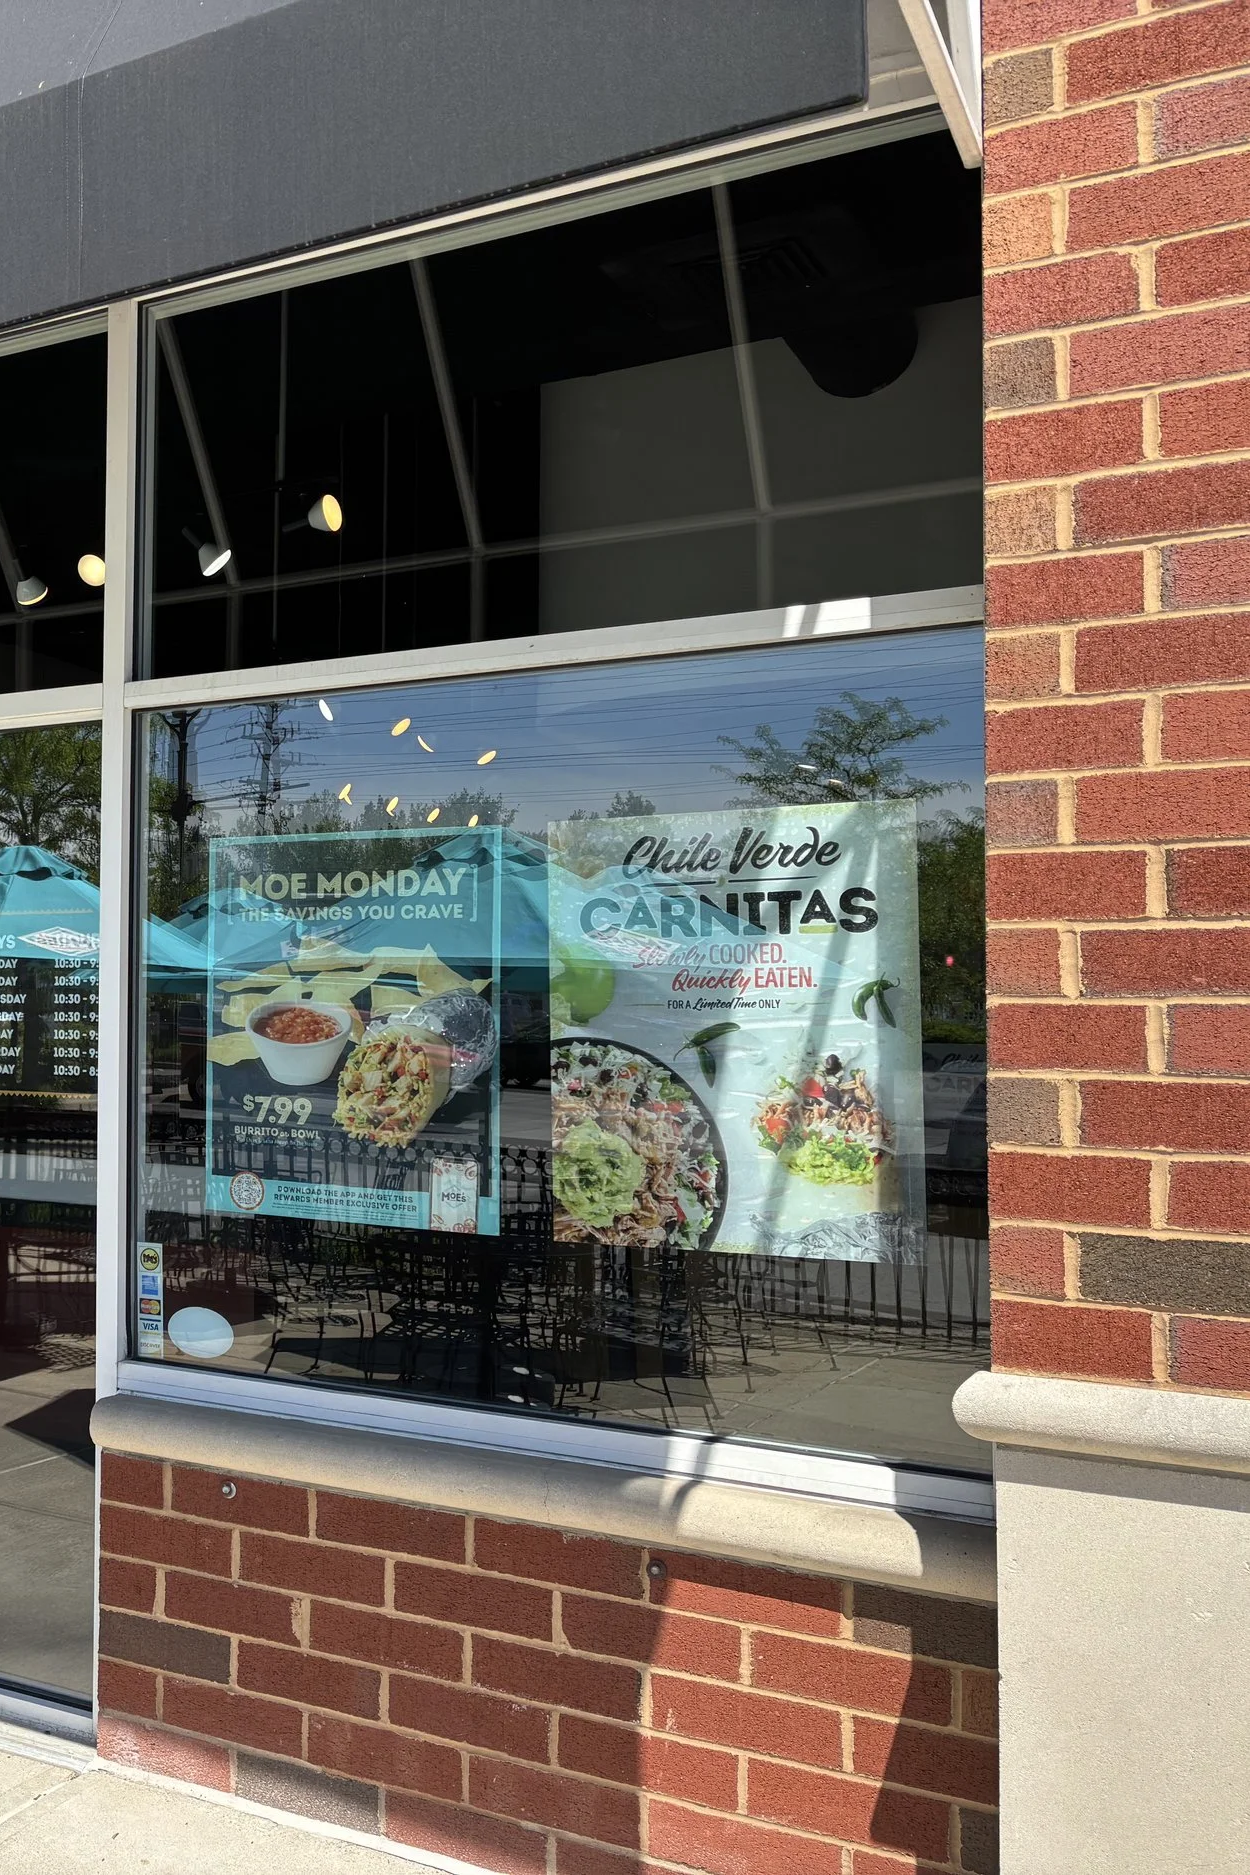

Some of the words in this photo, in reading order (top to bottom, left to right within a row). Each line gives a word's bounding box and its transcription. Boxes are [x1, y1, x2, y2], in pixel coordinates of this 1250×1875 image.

[622, 830, 721, 879] Chile
[728, 826, 841, 876] Verde
[239, 873, 307, 901] MOE
[317, 867, 467, 899] MONDAY
[240, 907, 270, 923] THE
[274, 905, 352, 922] SAVINGS
[358, 904, 396, 920] YOU
[400, 903, 464, 920] CRAVE
[579, 886, 879, 939] CARNITAS
[54, 959, 81, 969] 10:30
[632, 944, 707, 971] Slowly
[709, 943, 787, 965] COOKED.
[54, 976, 81, 986] 10:30
[671, 966, 751, 994] Quickly
[754, 966, 818, 989] EATEN.
[54, 994, 81, 1004] 10:30
[667, 1000, 684, 1010] FOR
[685, 1000, 692, 1009] A
[692, 998, 734, 1013] Limited
[733, 996, 757, 1010] Time
[758, 999, 781, 1009] ONLY
[54, 1011, 81, 1022] 10:30
[54, 1029, 81, 1040] 10:30
[54, 1047, 81, 1058] 10:30
[54, 1065, 81, 1076] 10:30
[242, 1094, 312, 1125] $7.99
[234, 1125, 279, 1137] BURRITO
[291, 1129, 321, 1139] BOWL
[274, 1193, 311, 1203] REWARDS
[312, 1197, 344, 1206] MEMBER
[346, 1200, 390, 1210] EXCLUSIVE
[391, 1203, 418, 1212] OFFER
[277, 1185, 322, 1196] DOWNLOAD
[324, 1189, 338, 1197] THE
[340, 1191, 356, 1199] APP
[358, 1192, 375, 1200] AND
[376, 1194, 393, 1202] GET
[393, 1195, 414, 1203] THIS
[142, 1322, 159, 1331] VISA
